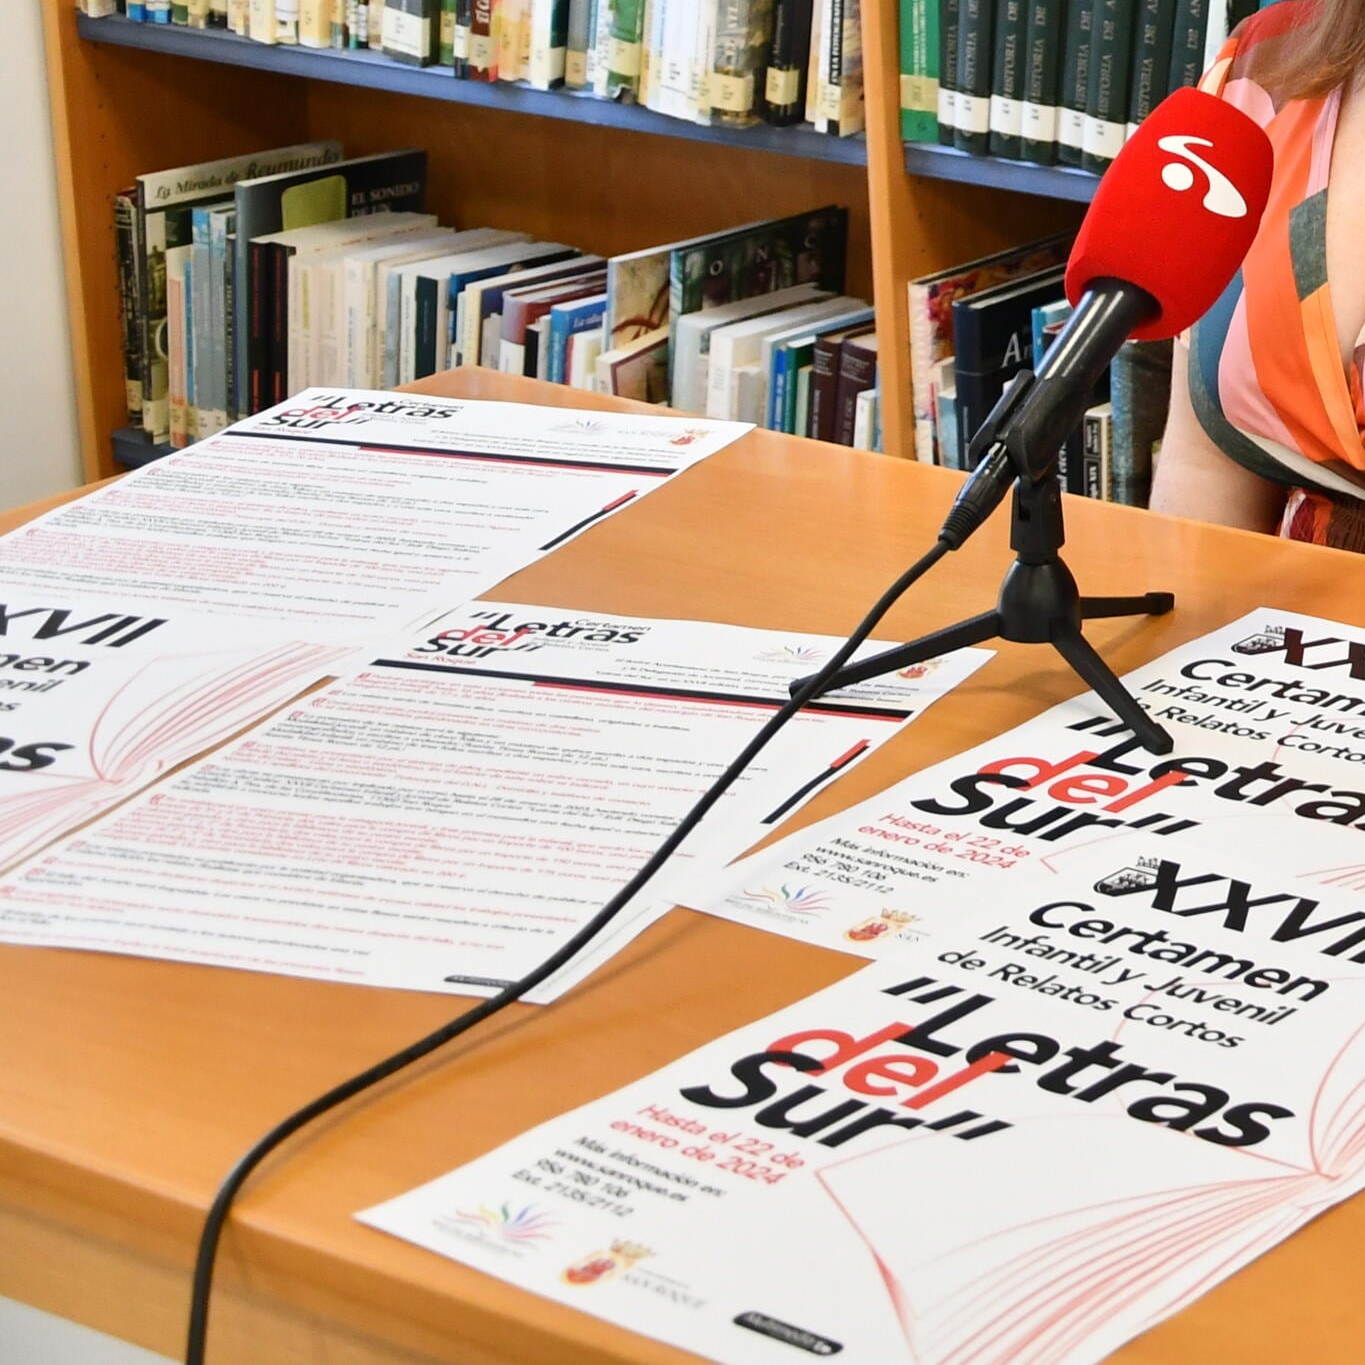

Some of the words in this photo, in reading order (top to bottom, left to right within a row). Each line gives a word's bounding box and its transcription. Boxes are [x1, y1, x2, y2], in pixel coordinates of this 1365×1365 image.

[283, 404, 362, 420] del
[437, 624, 533, 646] del
[1141, 678, 1264, 721] Infantil
[1263, 707, 1292, 723] y
[1154, 705, 1272, 742] Relatos
[976, 750, 1192, 813] del
[858, 825, 920, 846] enero
[924, 838, 953, 854] de
[954, 849, 1017, 870] 2024
[862, 845, 944, 872] información
[879, 814, 941, 835] Hasta
[944, 832, 970, 841] el
[968, 835, 1001, 850] 22
[1001, 843, 1030, 858] de
[979, 926, 1123, 976] Infantil
[1101, 966, 1145, 985] y
[1144, 976, 1297, 1026] Juvenil
[1028, 900, 1330, 1002] Certamen
[938, 948, 986, 970] de
[992, 962, 1119, 1011] Relatos
[1123, 1003, 1246, 1049] Cortos
[765, 1021, 1017, 1110] del
[573, 1135, 606, 1153] Más
[609, 1145, 699, 1187] información
[609, 1119, 680, 1149] enero
[681, 1141, 716, 1162] de
[716, 1155, 787, 1186] 2024
[637, 1104, 707, 1134] Hasta
[708, 1131, 741, 1144] el
[733, 1138, 775, 1155] 22
[770, 1151, 806, 1169] de
[554, 1147, 689, 1204] www.sanroque.es
